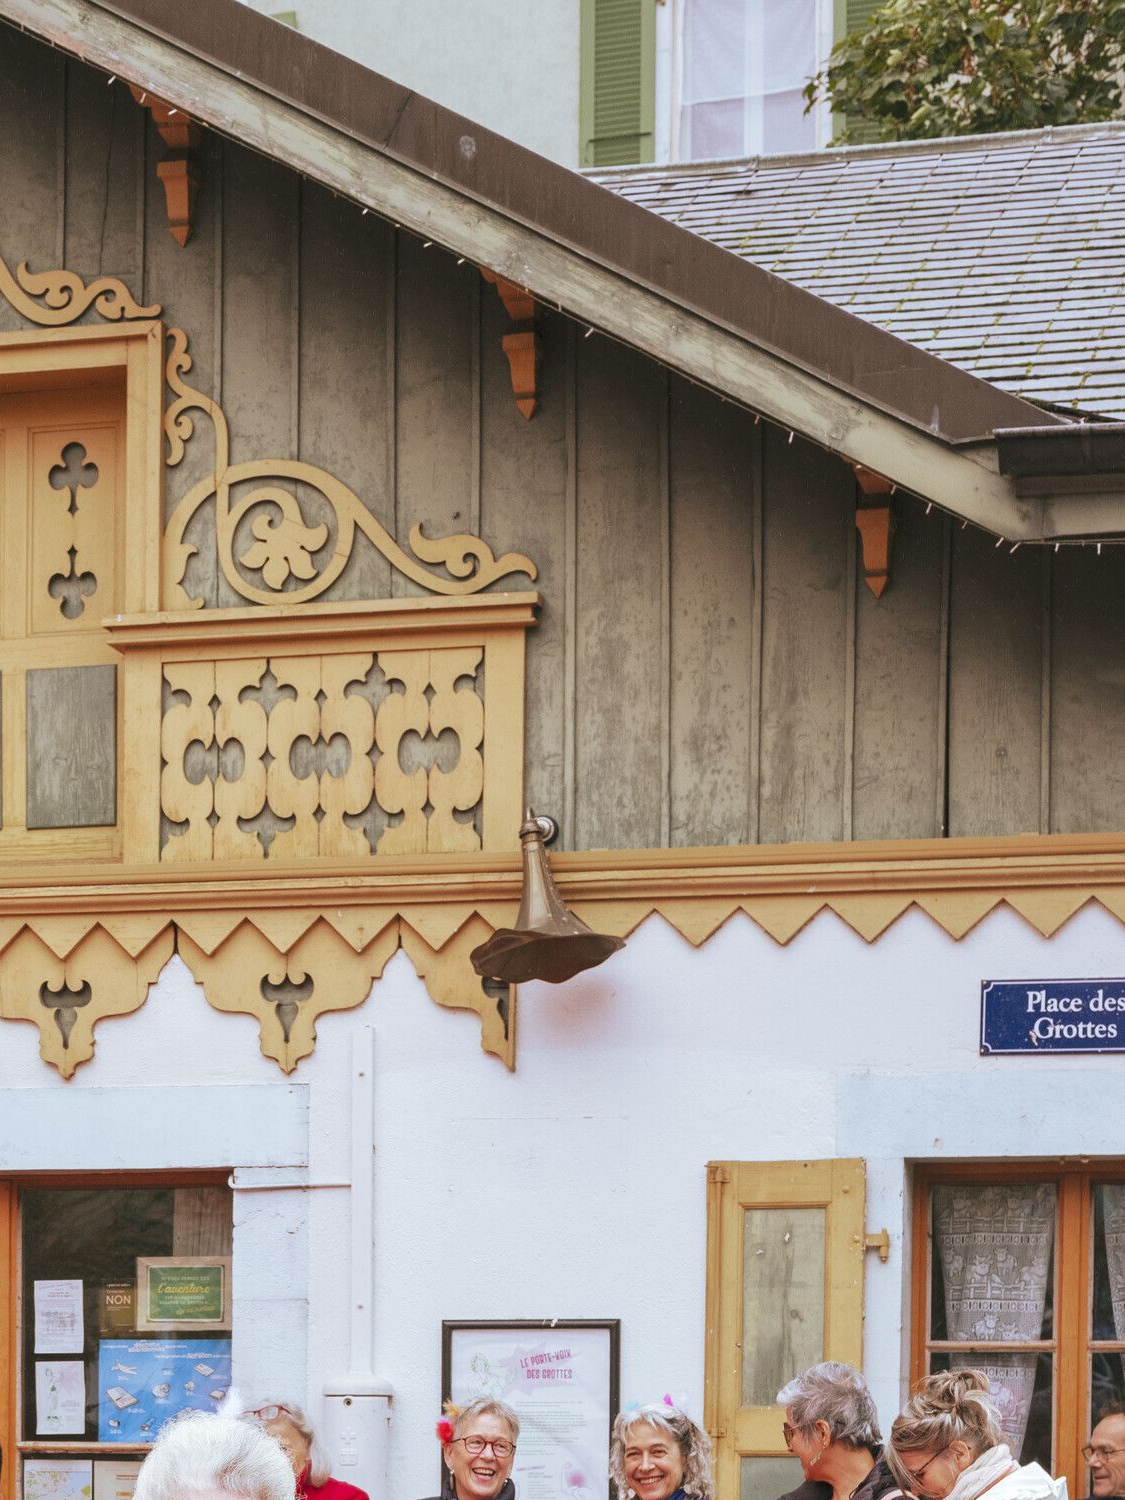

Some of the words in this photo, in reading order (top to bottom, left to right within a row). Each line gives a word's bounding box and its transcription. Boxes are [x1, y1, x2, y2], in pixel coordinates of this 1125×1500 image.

[1026, 989, 1082, 1013] Place
[1089, 989, 1125, 1013] des
[1033, 1017, 1118, 1039] Grottes
[106, 1294, 131, 1305] NON
[520, 1357, 529, 1368] LE
[530, 1348, 572, 1366] PORTE-VOIX
[526, 1369, 540, 1379] DES
[542, 1369, 573, 1379] GROTTES
